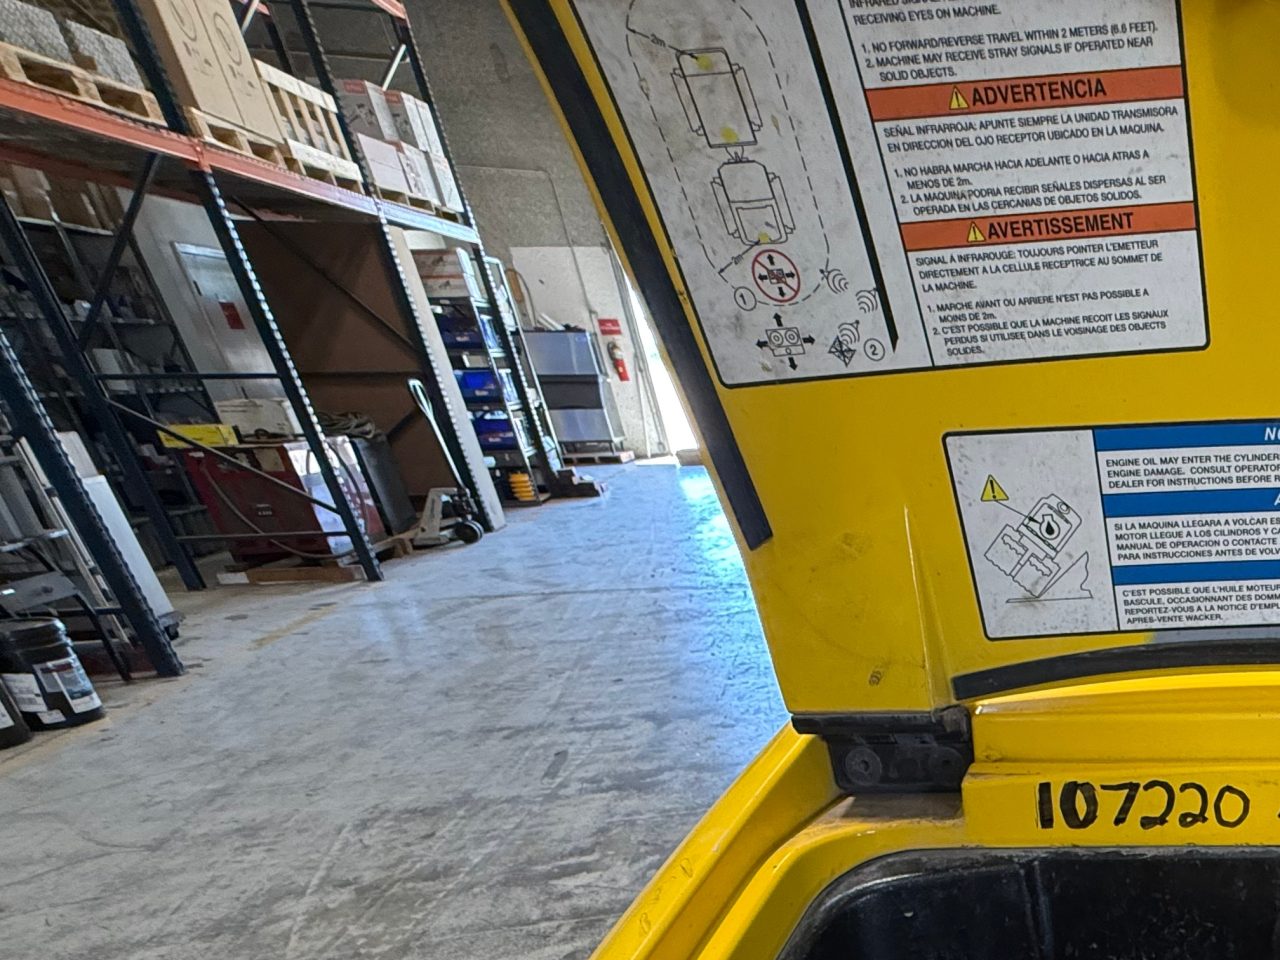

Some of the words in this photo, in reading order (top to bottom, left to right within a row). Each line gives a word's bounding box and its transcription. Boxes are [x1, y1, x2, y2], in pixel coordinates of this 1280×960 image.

[852, 12, 907, 26] RECEIVING
[907, 10, 935, 21] EYES
[934, 9, 951, 19] ON
[951, 5, 1001, 18] MACHINE.
[650, 33, 666, 47] 2m
[871, 42, 888, 53] NO
[888, 35, 985, 52] FORWARD/REVERSE
[986, 32, 1023, 44] TRAVEL
[1023, 29, 1060, 41] WITHIN
[1060, 29, 1068, 39] 2
[1068, 26, 1109, 38] METERS
[864, 58, 875, 69] 2.
[874, 55, 921, 68] MACHINE
[921, 53, 944, 64] MAY
[944, 50, 986, 62] RECEIVE
[986, 47, 1019, 59] STRAY
[1019, 44, 1062, 56] SIGNALS
[1063, 43, 1073, 53] IF
[1073, 39, 1125, 52] OPERATED
[1126, 37, 1153, 48] NEAR
[878, 70, 909, 82] SOLID
[909, 67, 957, 80] OBJECTS.
[972, 77, 1107, 107] ADVERTENCIA
[882, 124, 915, 137] SEÑAL
[977, 118, 1016, 130] APUNTE
[1017, 115, 1060, 127] SIEMPRE
[1060, 114, 1073, 124] LA
[1073, 111, 1111, 123] UNIDAD
[1111, 106, 1178, 120] TRANSMISORA
[988, 212, 1134, 240] AVERTISSEMENT
[1105, 458, 1140, 468] ENGINE
[1141, 458, 1158, 466] OIL
[1159, 457, 1179, 466] MAY
[1181, 456, 1212, 465] ENTER
[1214, 456, 1232, 464] THE
[1106, 469, 1141, 478] ENGINE
[1142, 467, 1185, 477] DAMAGE.
[1189, 466, 1232, 475] CONSULT
[1107, 479, 1144, 488] DEALER
[1145, 479, 1165, 487] FOR
[1166, 476, 1234, 487] INSTRUCTIONS
[1235, 475, 1272, 484] BEFORE
[1036, 780, 1250, 830] 107220
